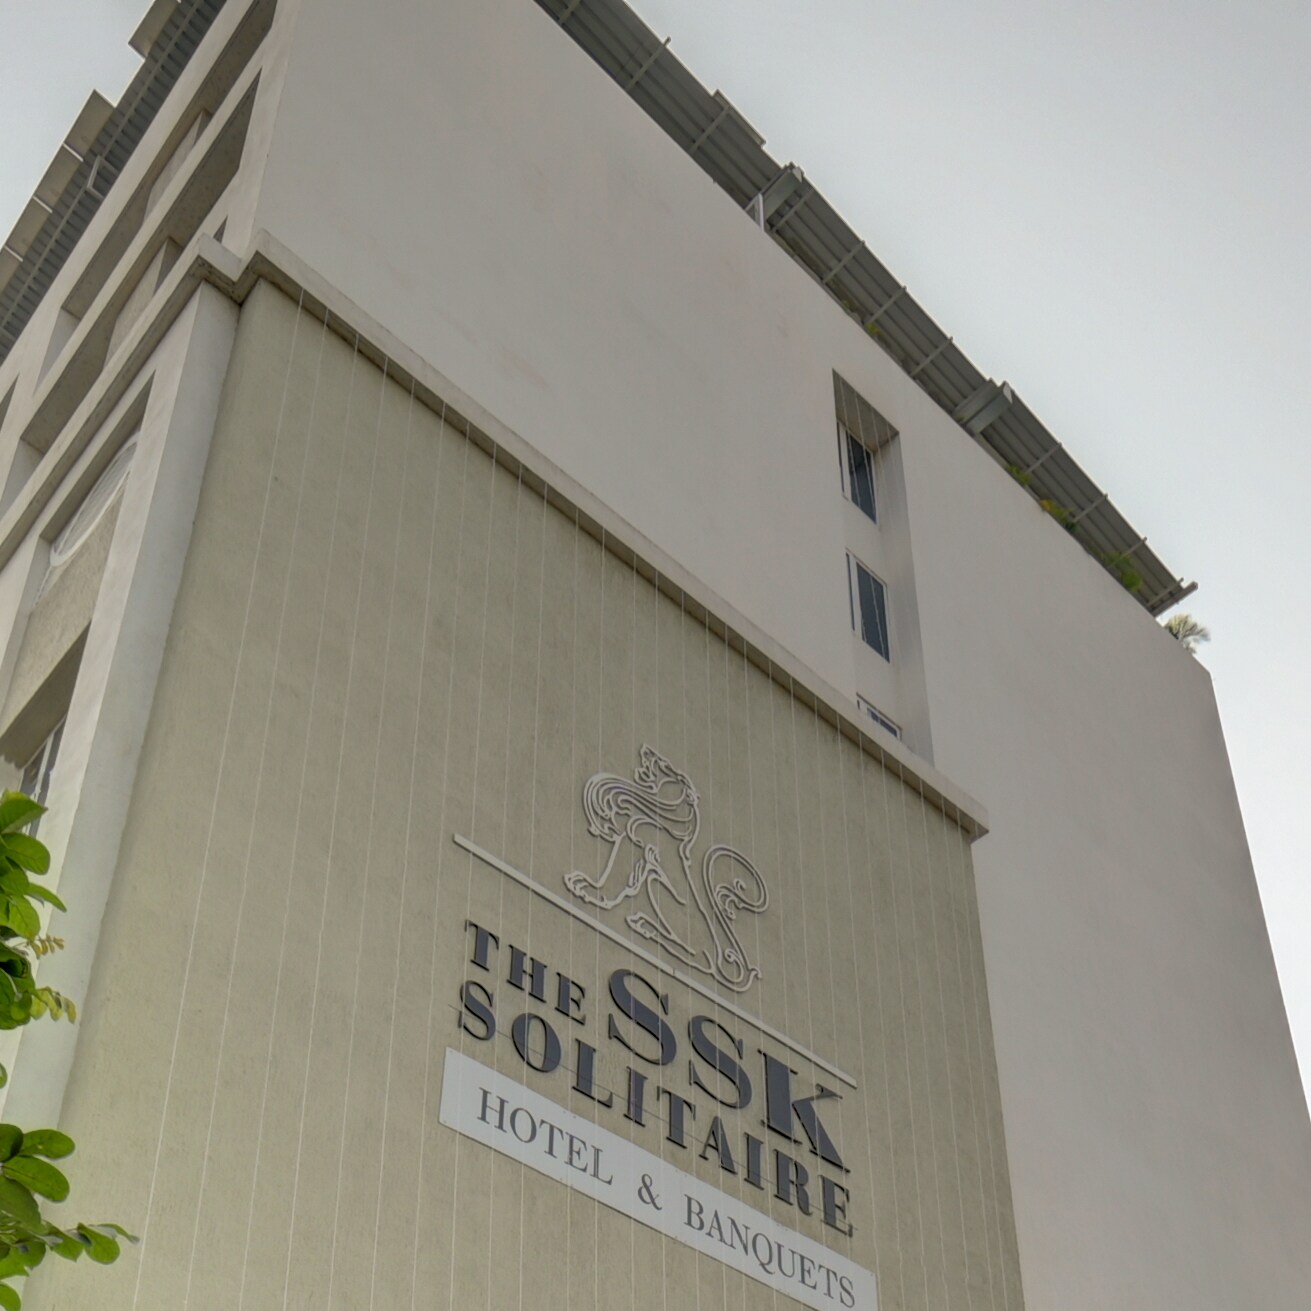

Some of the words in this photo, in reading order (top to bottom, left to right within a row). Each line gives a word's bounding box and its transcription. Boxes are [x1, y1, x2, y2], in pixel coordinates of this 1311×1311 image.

[458, 980, 853, 1238] SOLITAIRE
[465, 919, 587, 1025] THE
[608, 968, 850, 1173] SSK
[476, 1087, 613, 1186] HOTEL
[637, 1173, 663, 1212] &
[683, 1194, 856, 1309] BANQUETS
